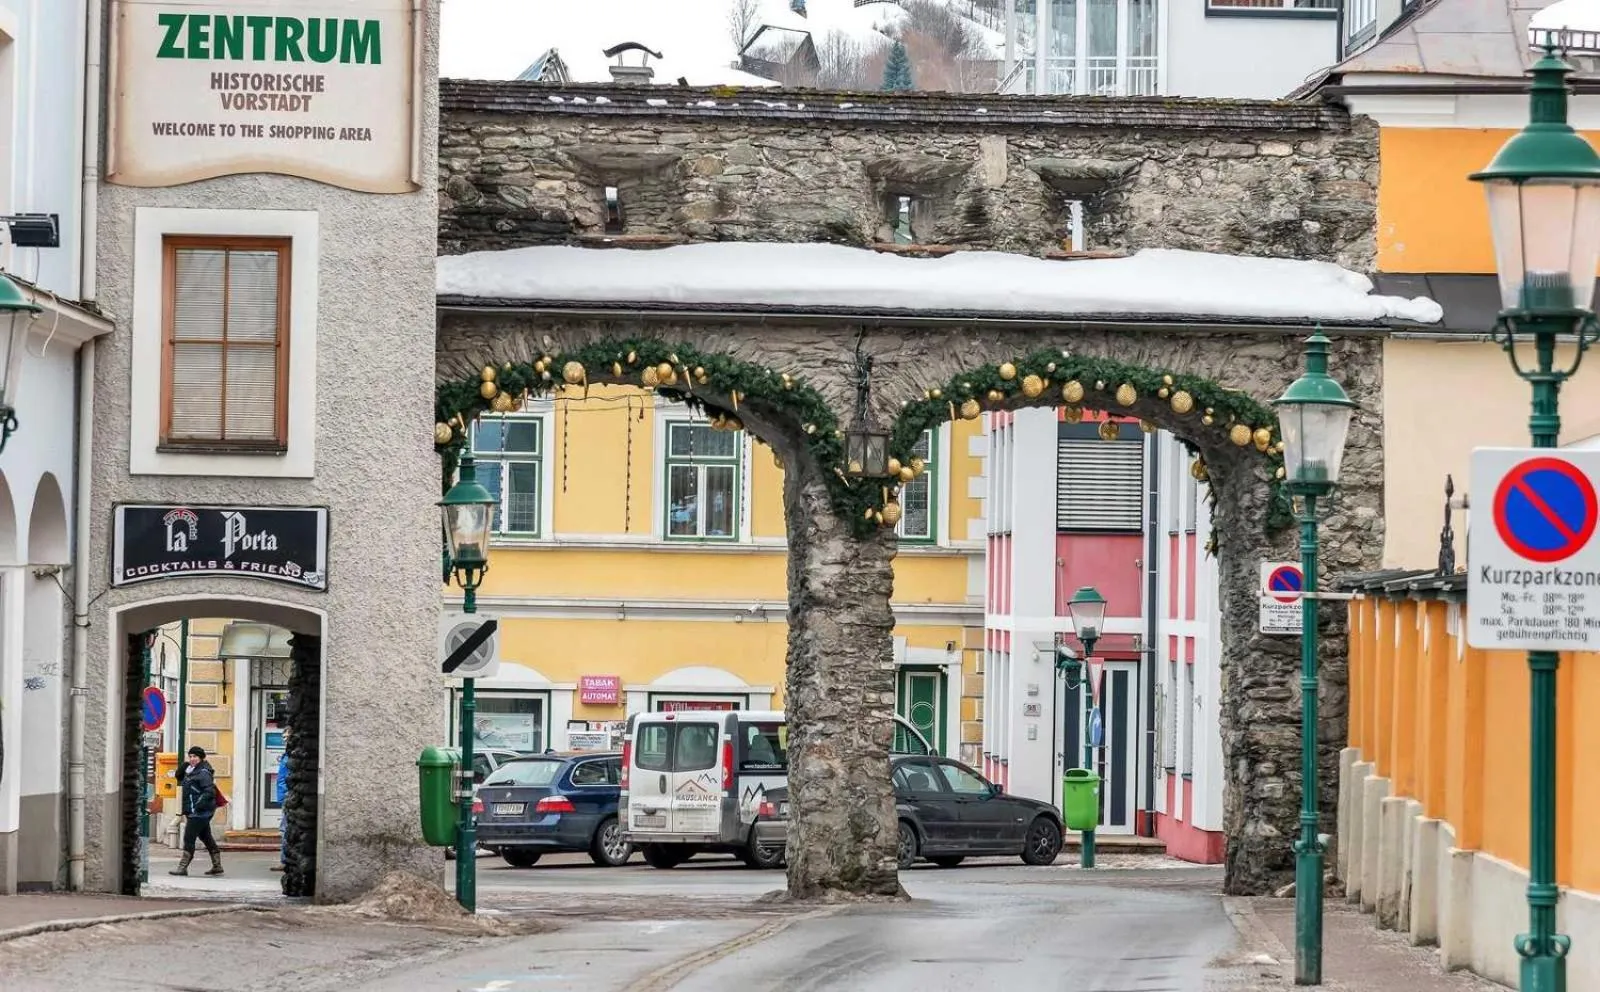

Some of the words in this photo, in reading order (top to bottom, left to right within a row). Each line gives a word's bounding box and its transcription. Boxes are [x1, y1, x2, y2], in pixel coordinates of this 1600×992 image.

[156, 13, 382, 65] ZENTRUM
[210, 72, 325, 92] HISTORISCHE
[220, 93, 312, 112] VORSTADT
[152, 122, 215, 137] WELCOME
[219, 124, 236, 137] TO
[240, 125, 264, 138] THE
[269, 125, 335, 140] SHOPPING
[339, 127, 372, 141] AREA
[220, 511, 278, 559] Porta
[126, 560, 217, 577] COCKTAILS
[224, 561, 234, 569] &
[1480, 617, 1504, 627] max.
[1508, 616, 1559, 628] Parkdauer
[1564, 617, 1580, 628] 180
[1496, 628, 1588, 641] gebührenpflichtig
[584, 678, 614, 687] TABAK
[582, 692, 616, 700] AUTOMAT
